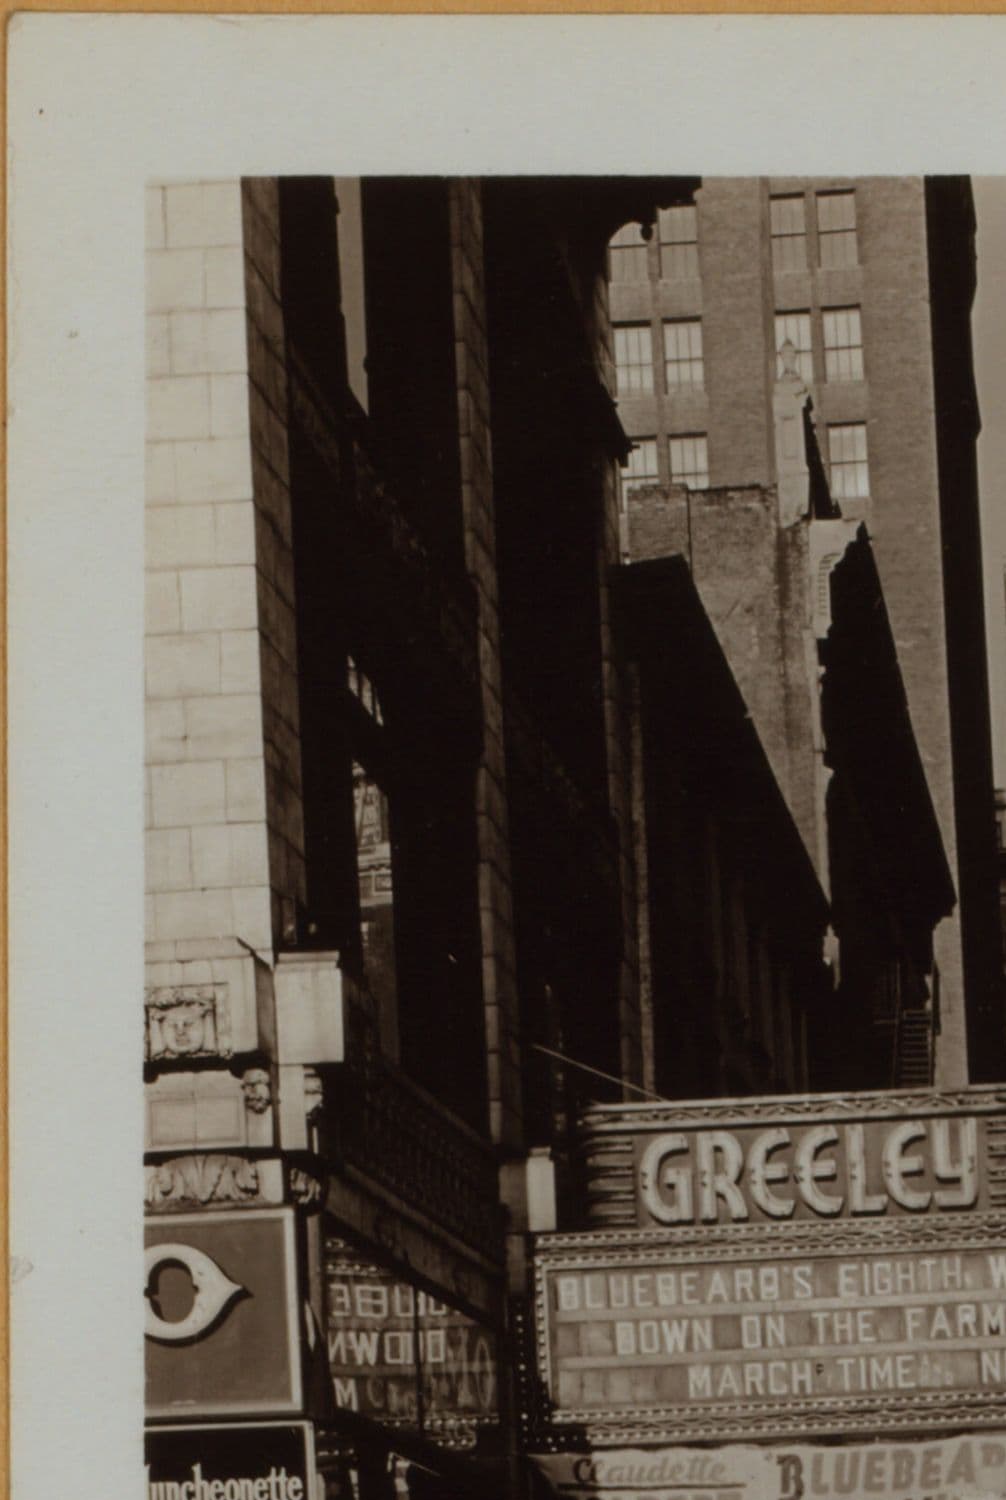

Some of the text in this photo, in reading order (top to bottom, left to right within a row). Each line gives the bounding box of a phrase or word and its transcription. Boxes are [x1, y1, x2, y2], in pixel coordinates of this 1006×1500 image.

[640, 1117, 979, 1225] GREELEY
[838, 1255, 962, 1298] EIGHTH
[615, 1301, 1006, 1355] DOWN ON THE FARM
[688, 1360, 813, 1399] MARCH
[836, 1354, 917, 1391] TIME
